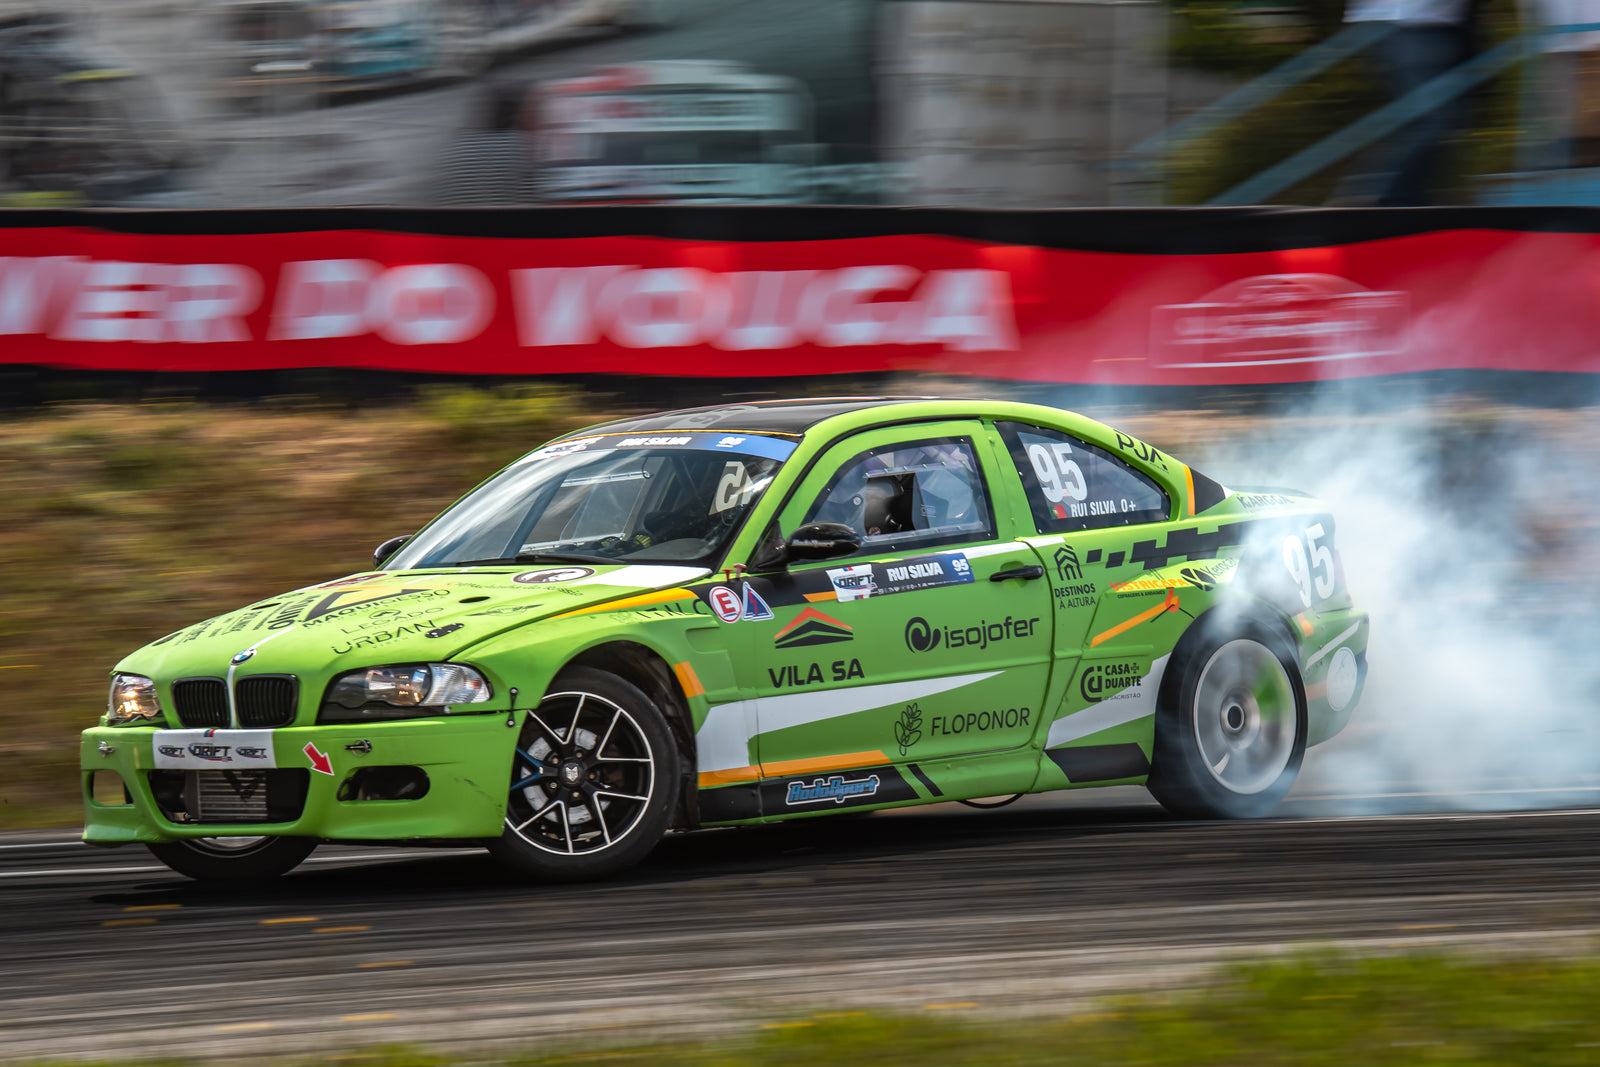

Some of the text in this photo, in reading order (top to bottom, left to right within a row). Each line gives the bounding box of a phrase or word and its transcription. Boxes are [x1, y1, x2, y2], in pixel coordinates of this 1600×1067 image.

[268, 258, 497, 345] DO
[1028, 442, 1088, 503] 95
[1070, 503, 1088, 518] RUI
[1089, 500, 1117, 516] SILVA
[839, 573, 873, 588] DRIFT
[886, 566, 909, 581] RUI
[908, 561, 944, 579] SILVA
[951, 558, 969, 572] 95
[1283, 523, 1335, 608] 95
[1054, 583, 1096, 598] DESTINOS
[1109, 578, 1190, 592] VISTRICAPA
[301, 589, 450, 628] MAQUIGESSO
[715, 592, 737, 615] E
[1067, 596, 1097, 608] ALTURA
[341, 607, 444, 634] LEGADO
[944, 616, 1040, 650] isojofer
[331, 620, 437, 655] URBAN
[768, 658, 865, 688] VILA SA
[1105, 663, 1130, 676] CASA
[1105, 675, 1141, 689] DUARTE
[931, 707, 1030, 736] FLOPONOR
[193, 745, 232, 757] DRIFT
